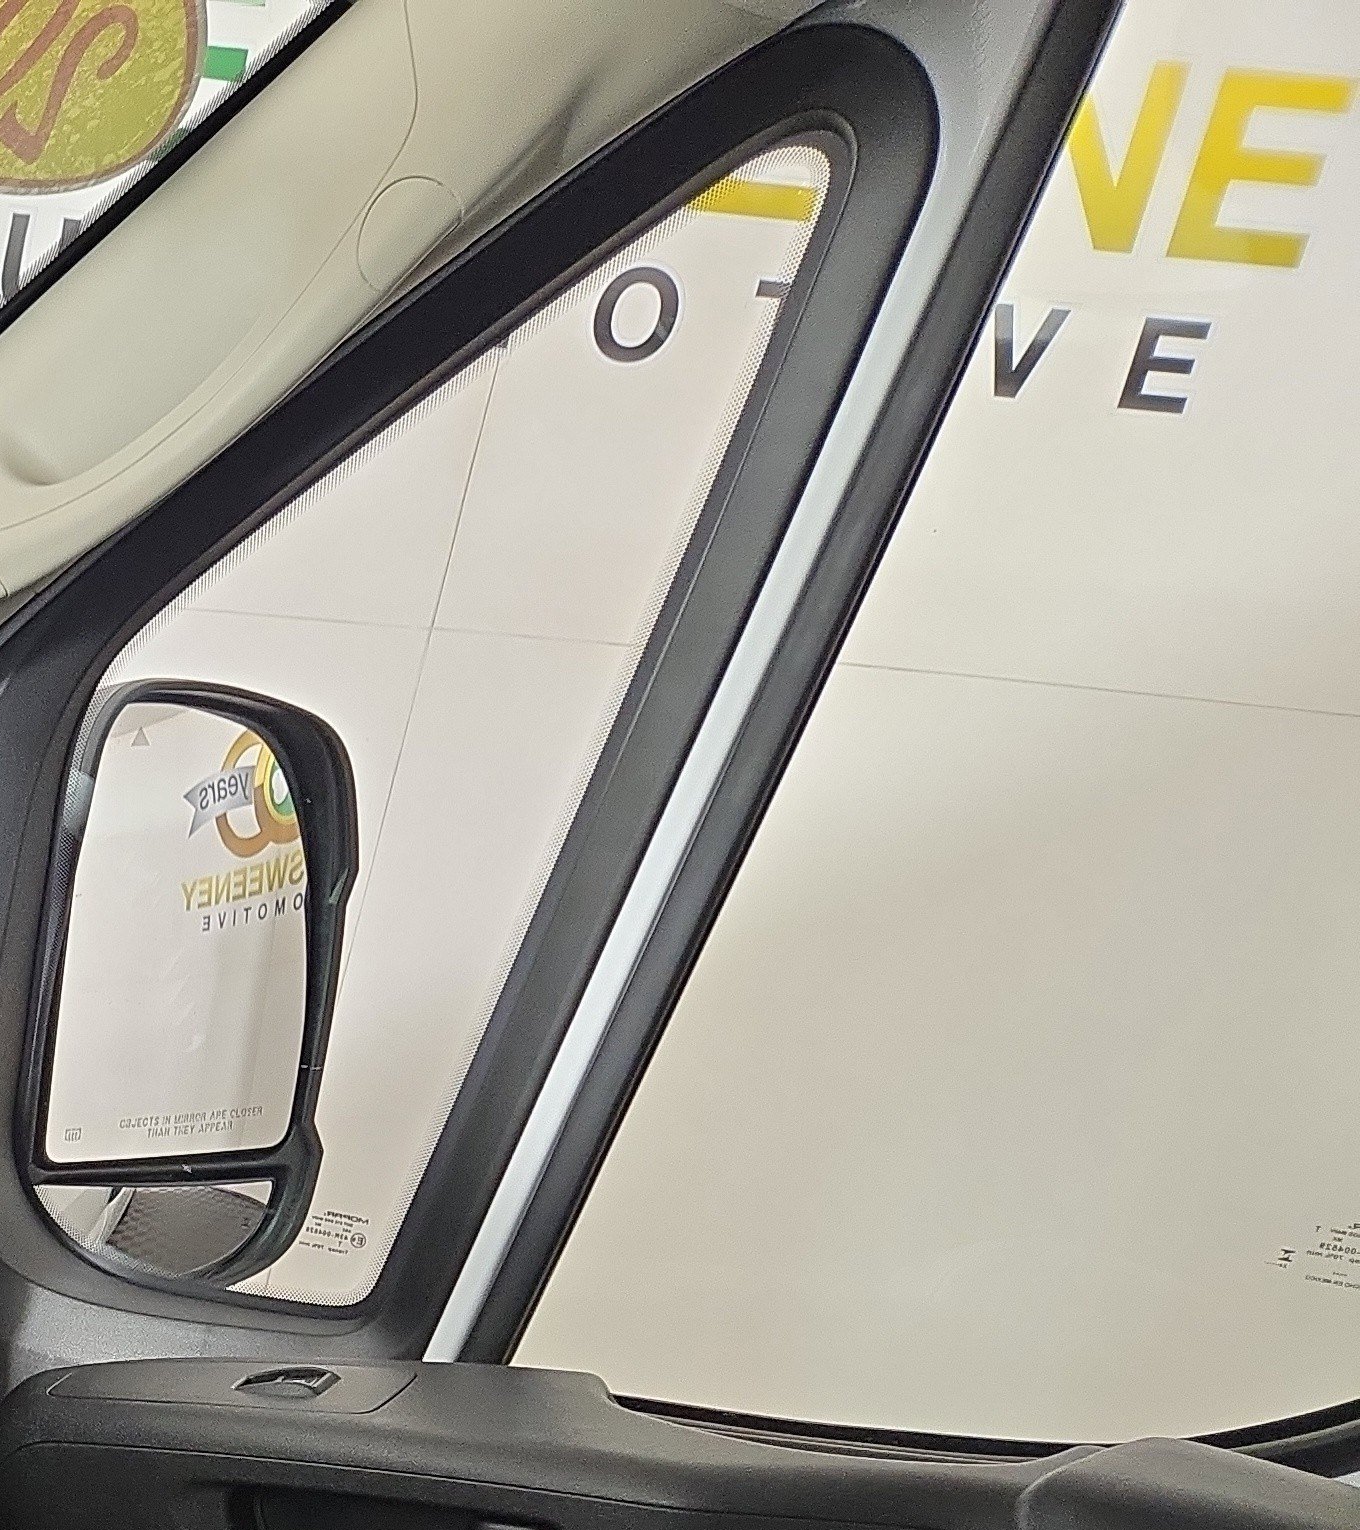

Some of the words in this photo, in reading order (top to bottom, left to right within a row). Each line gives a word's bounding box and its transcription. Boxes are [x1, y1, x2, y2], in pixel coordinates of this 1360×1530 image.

[119, 1116, 160, 1129] OBJECTS
[162, 1115, 171, 1126] IN
[173, 1112, 206, 1124] MIRROR
[210, 1109, 227, 1121] ARE
[230, 1106, 263, 1118] CLOSER
[147, 1126, 170, 1138] THAN
[174, 1124, 195, 1136] THEY
[198, 1121, 234, 1133] APPEAR
